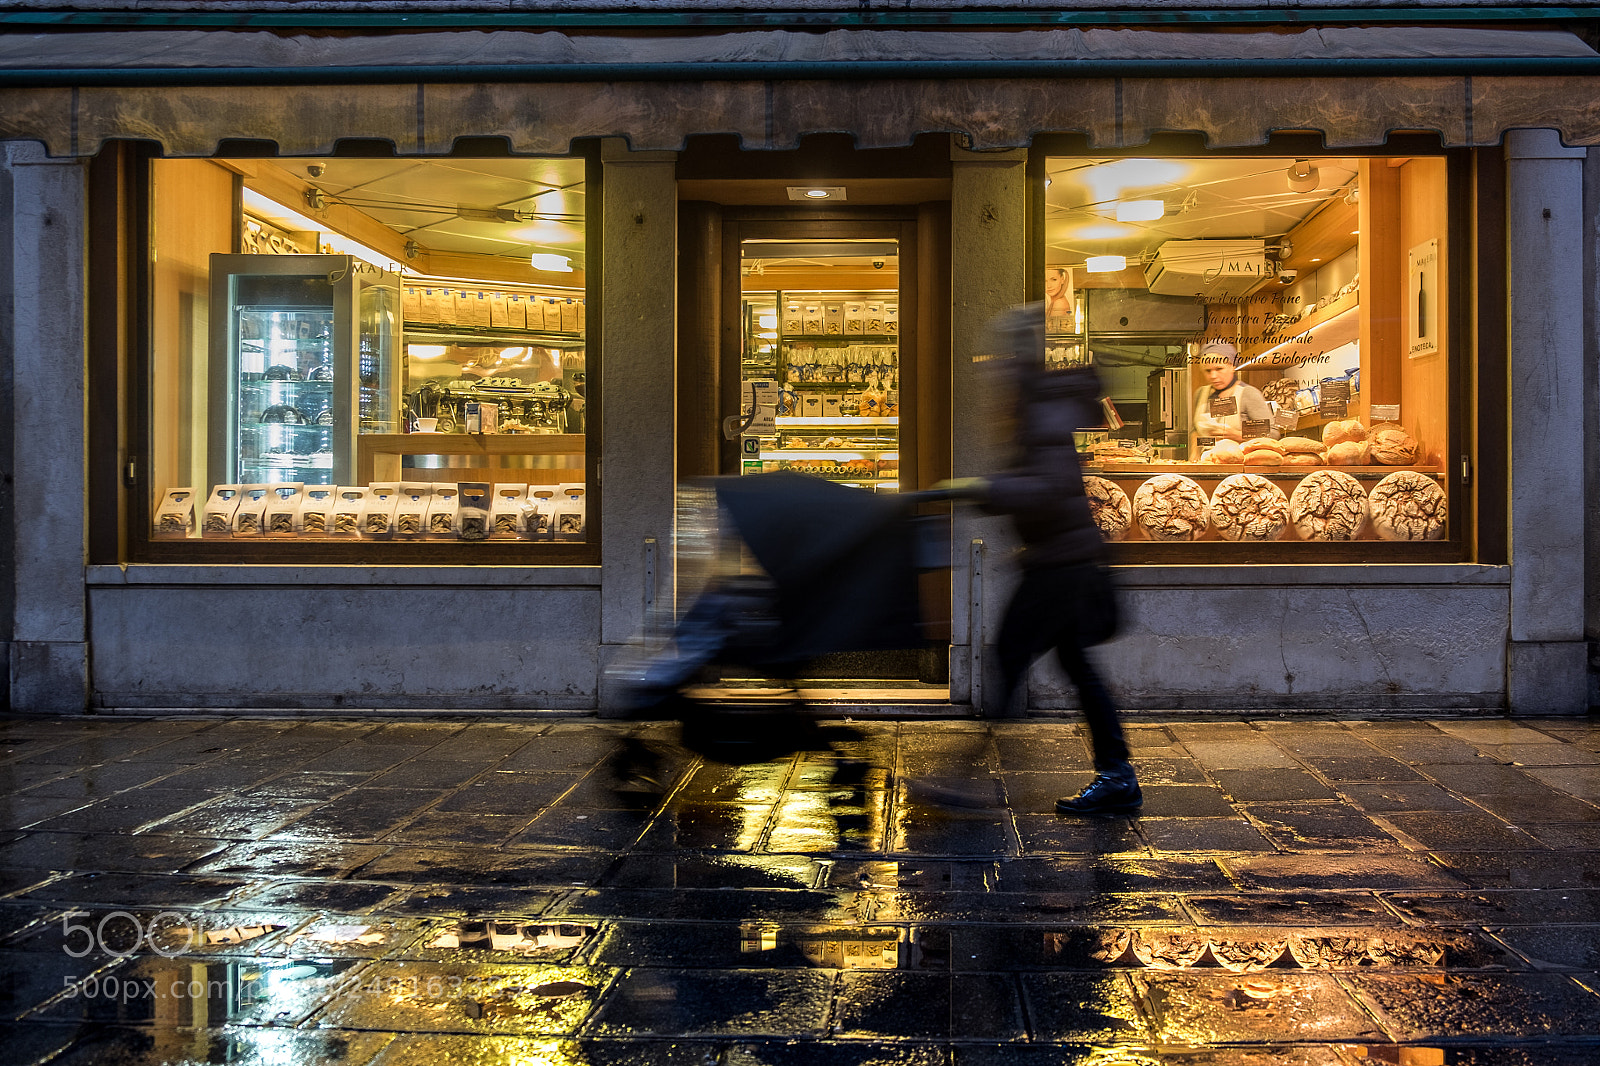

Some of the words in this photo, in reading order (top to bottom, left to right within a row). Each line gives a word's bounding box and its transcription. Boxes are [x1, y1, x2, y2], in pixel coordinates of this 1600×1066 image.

[353, 262, 408, 279] MAJER
[1228, 260, 1285, 276] MAJER
[1229, 293, 1267, 304] nostro
[1221, 314, 1260, 325] nostra
[1264, 312, 1299, 326] Pizza
[1263, 330, 1313, 346] naturale
[1411, 342, 1432, 354] ENOTECA
[1232, 351, 1267, 367] farine
[1271, 350, 1331, 369] Biologiche
